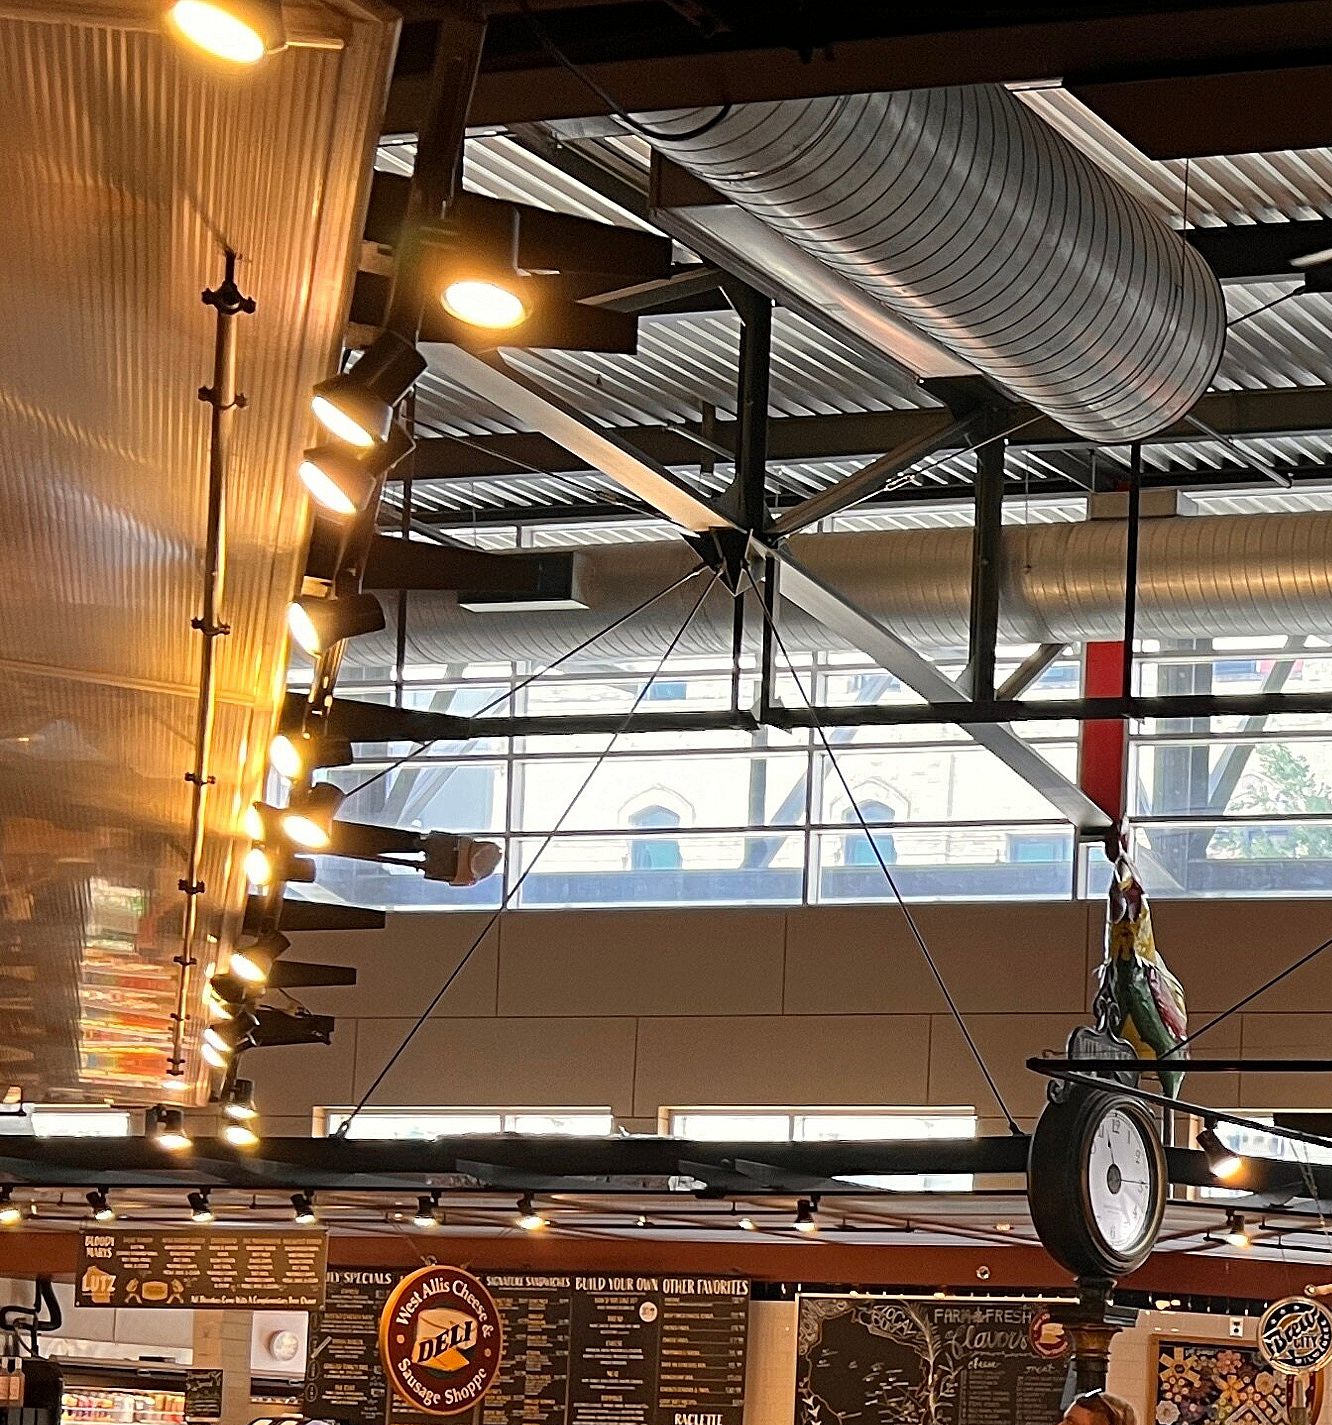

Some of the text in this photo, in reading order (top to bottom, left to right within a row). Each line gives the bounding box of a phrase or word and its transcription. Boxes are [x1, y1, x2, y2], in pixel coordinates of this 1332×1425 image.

[344, 1273, 392, 1285] SPECIALS
[486, 1277, 571, 1288] SIGNATURE SANDWICHES
[575, 1279, 659, 1292] BUILD YOUR OWN
[662, 1279, 749, 1295] OTHER FAVORITES
[395, 1278, 494, 1338] West Allis Cheese &
[986, 1309, 1032, 1324] FRESH
[417, 1320, 473, 1363] DELI
[1293, 1335, 1318, 1349] CITY
[398, 1358, 487, 1406] Sausage Shoppe
